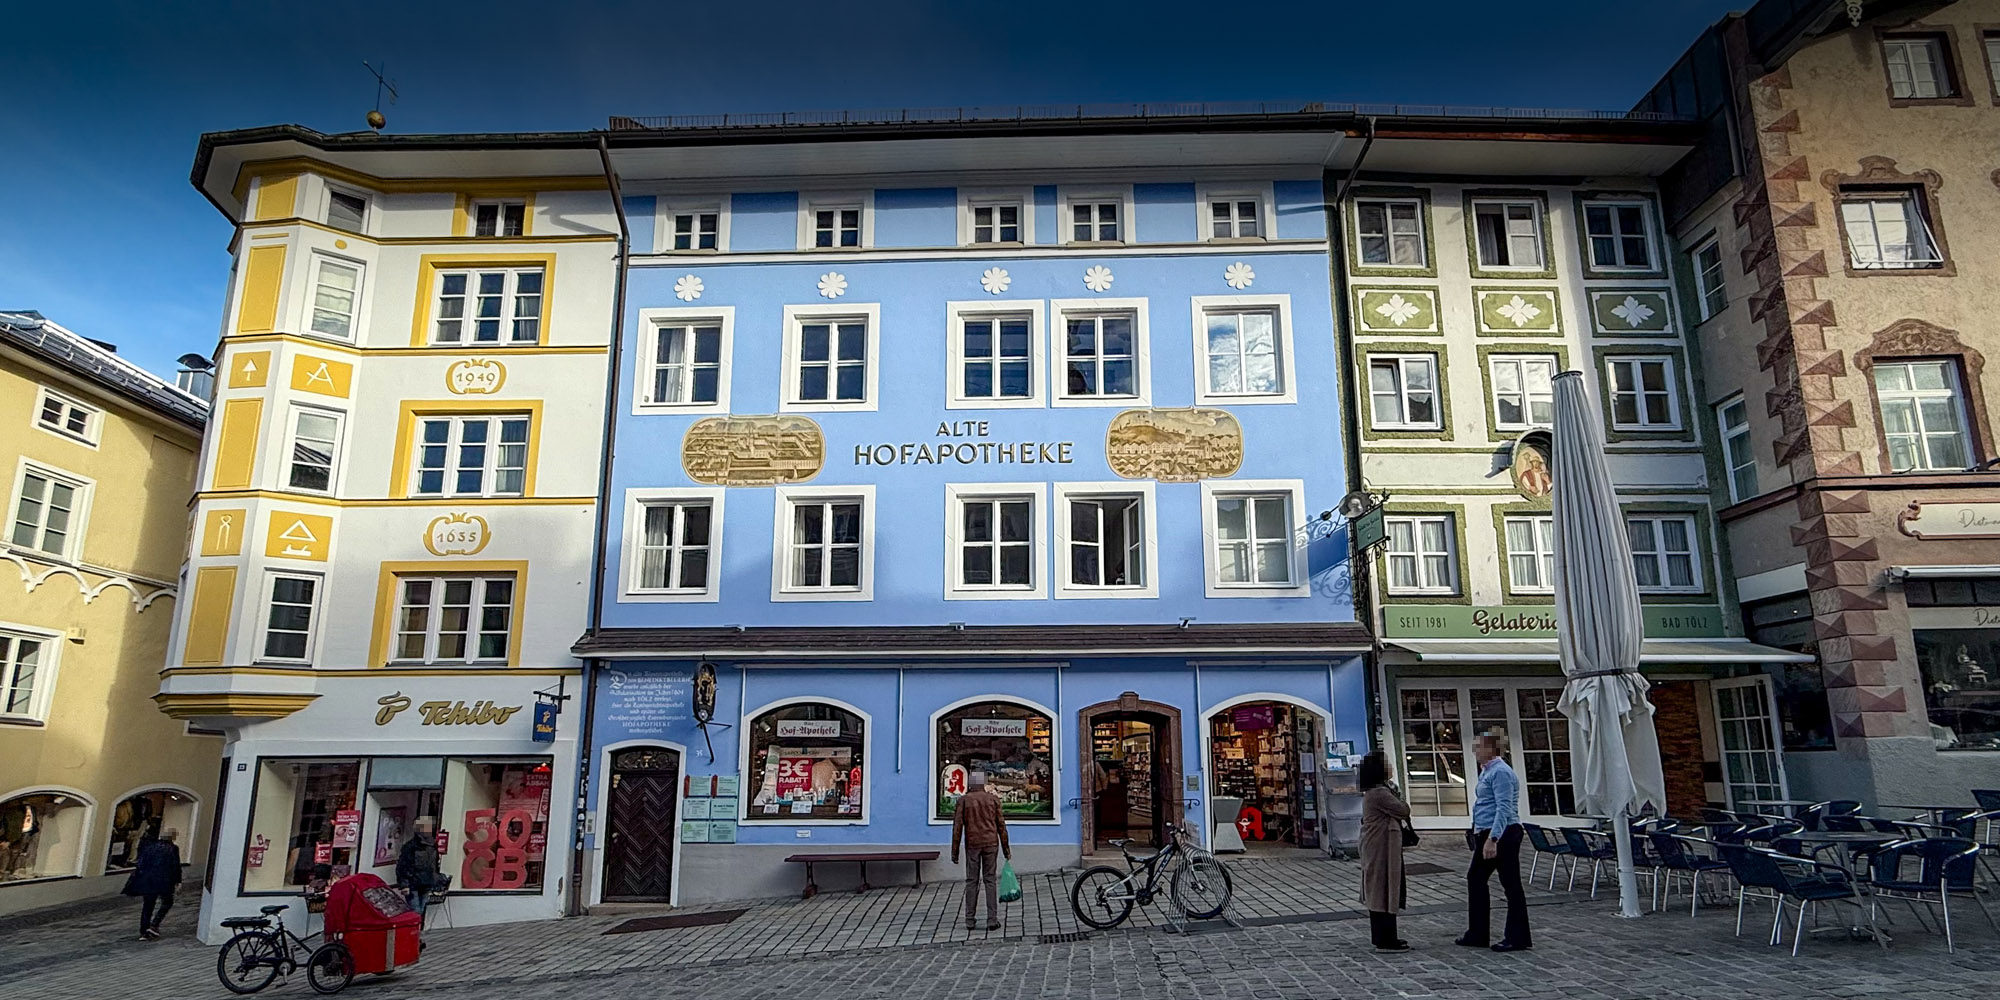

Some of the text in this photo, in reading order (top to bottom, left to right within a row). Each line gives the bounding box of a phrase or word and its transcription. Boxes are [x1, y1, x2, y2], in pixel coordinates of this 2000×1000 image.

[456, 372, 496, 386] 1949
[936, 421, 990, 437] ALTE
[854, 441, 1074, 466] HOFAPOTHEKE
[437, 529, 477, 543] 1635
[1400, 617, 1447, 628] SEIT 1981
[1662, 616, 1708, 628] BAD TÖLZ
[418, 700, 523, 725] Tchibo
[779, 759, 809, 777] 3€
[464, 808, 533, 852] 50
[462, 848, 529, 889] GB
